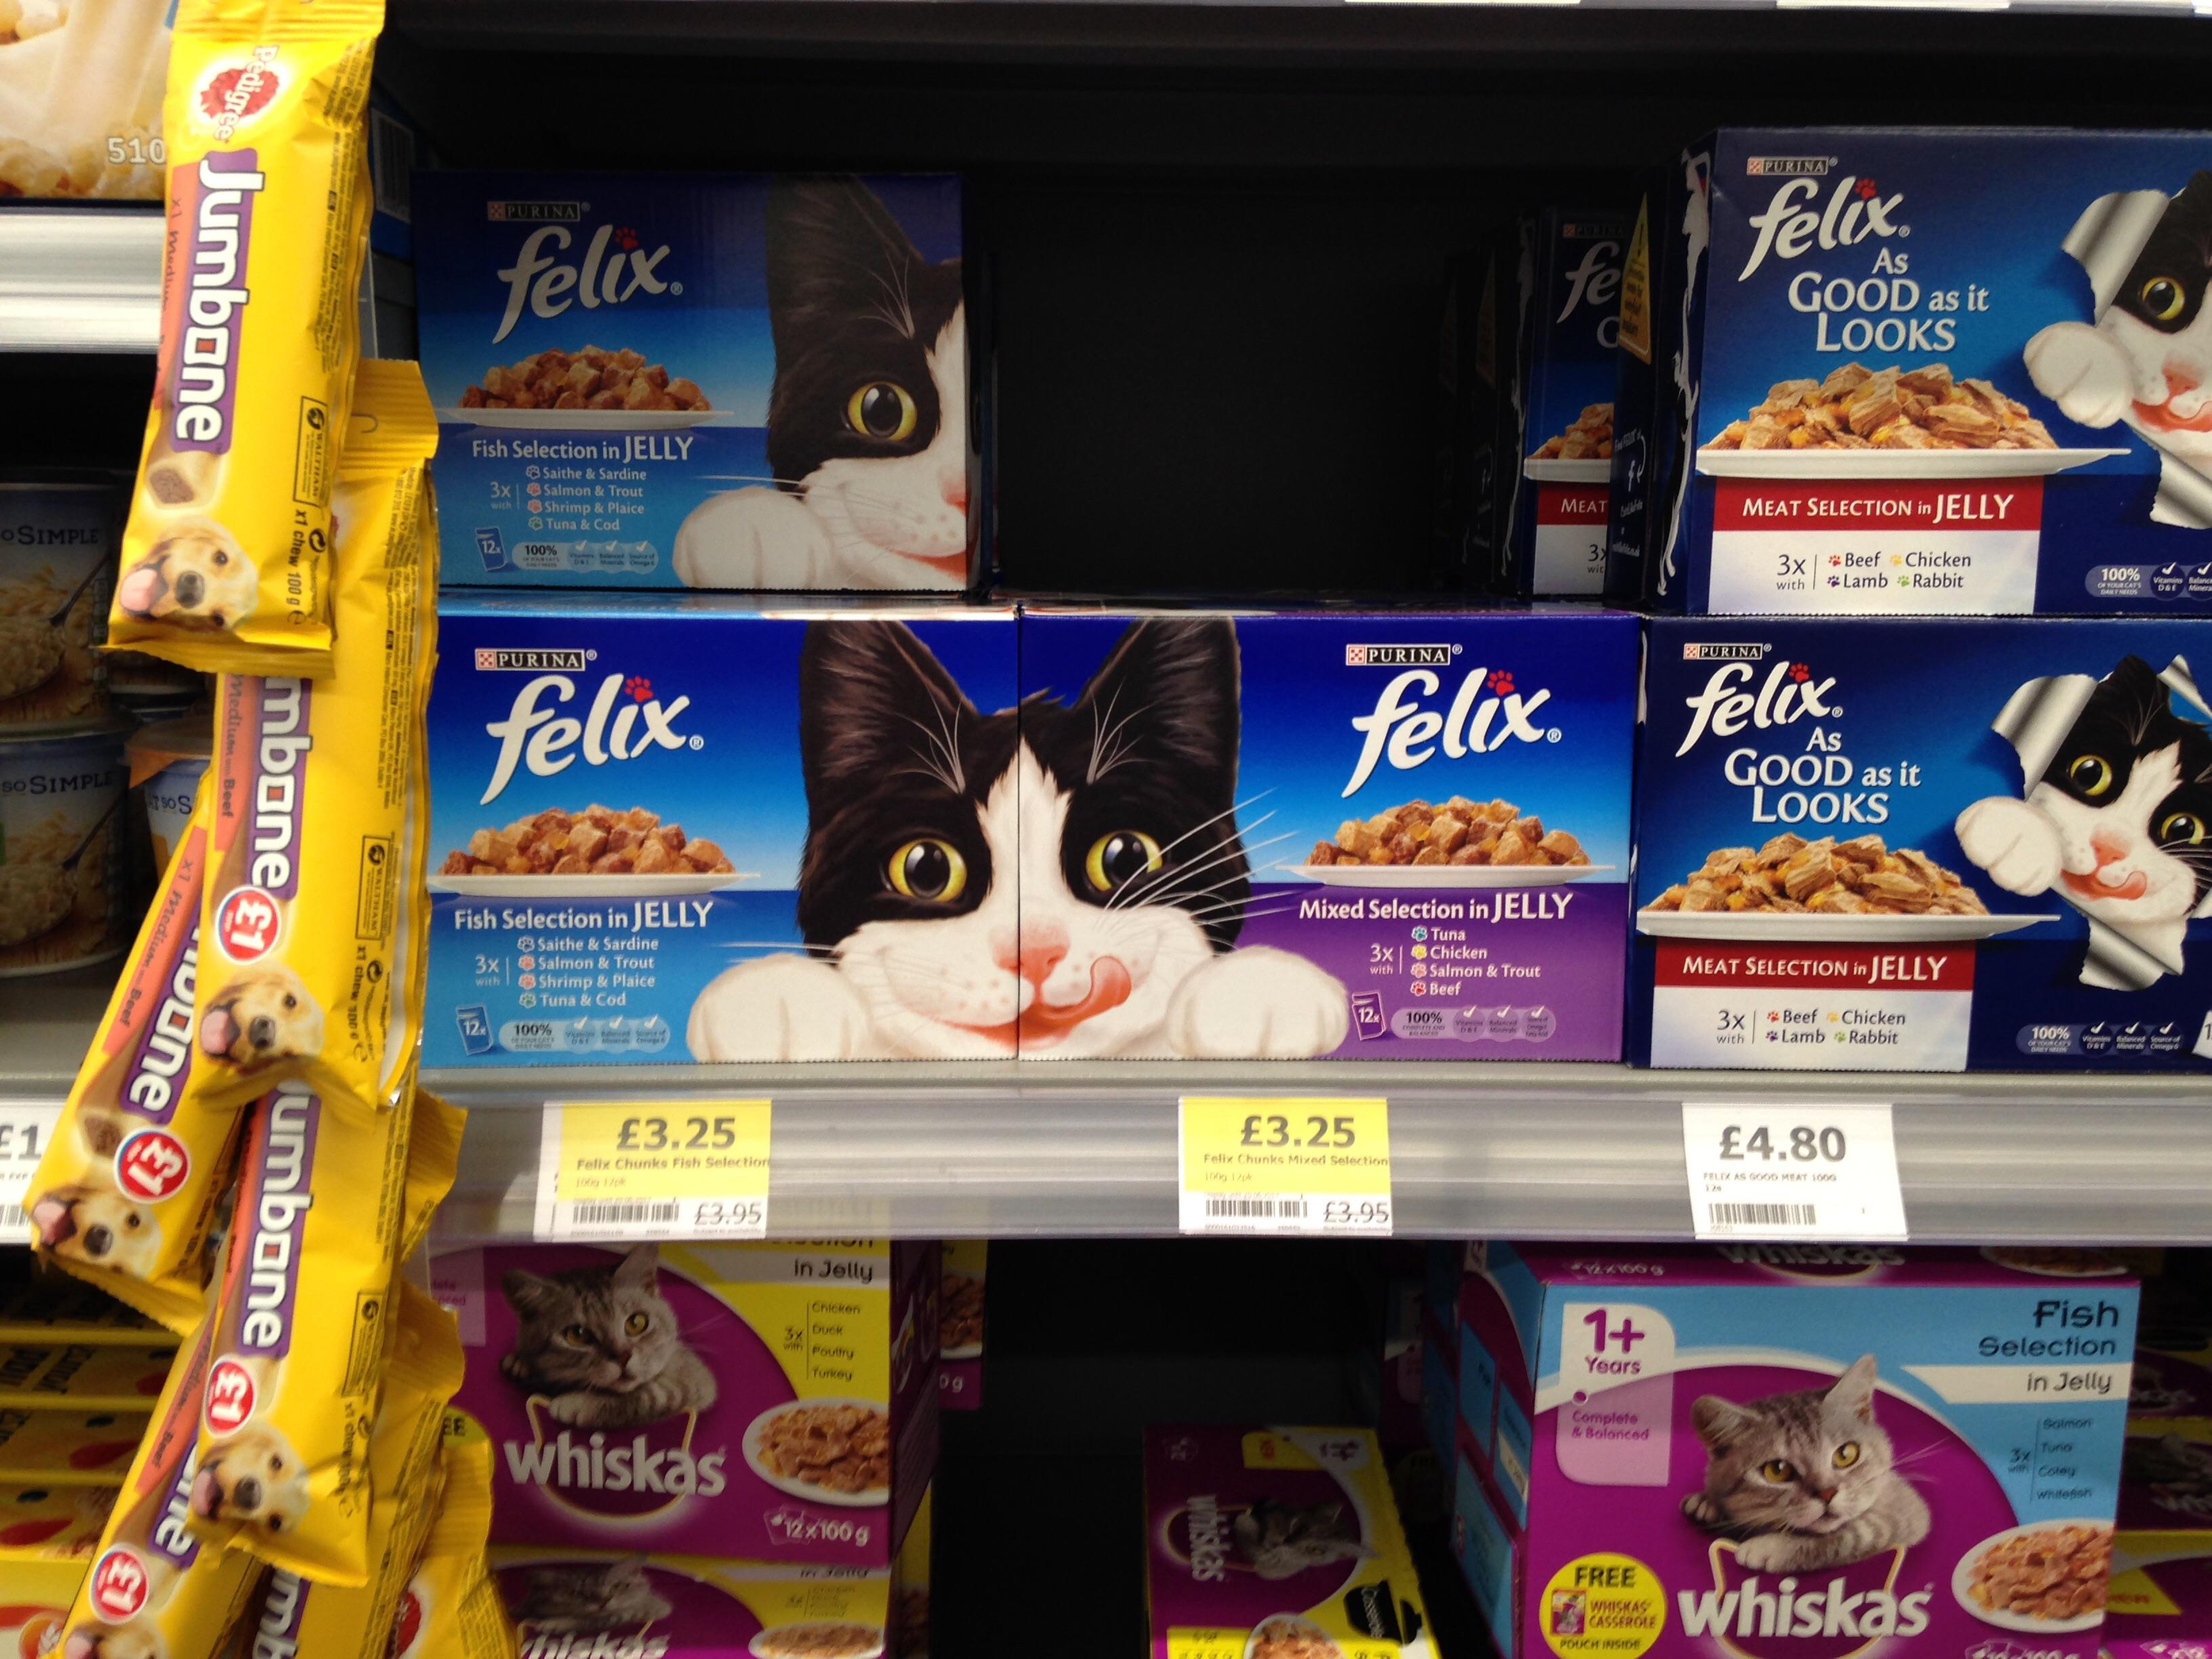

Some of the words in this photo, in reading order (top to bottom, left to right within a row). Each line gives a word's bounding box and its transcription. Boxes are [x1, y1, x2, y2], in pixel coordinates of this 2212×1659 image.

[213, 45, 279, 140] Pedigree
[1763, 161, 1826, 173] PURINA
[508, 204, 575, 219] PURINA
[1738, 176, 1904, 282] felix
[1872, 247, 1909, 274] As
[492, 224, 670, 344] felix
[1788, 272, 1920, 313] GOOD
[1928, 291, 1959, 312] as
[1967, 284, 1990, 312] it
[175, 159, 265, 442] Jumbone
[1816, 312, 1957, 352] LOOKS
[473, 439, 508, 458] Fish
[513, 440, 600, 459] Selection
[602, 441, 620, 459] in
[623, 436, 694, 464] JELLY
[544, 468, 583, 480] Saithe
[599, 468, 647, 480] Sardine
[544, 484, 592, 497] Salmon
[609, 485, 644, 497] Trout
[544, 501, 591, 515] Shrimp
[608, 501, 644, 514] Plaice
[1561, 498, 1608, 514] MEAT
[1742, 497, 1803, 518] MEAT
[1807, 497, 1912, 518] SELECTION
[1918, 499, 1931, 516] in
[1933, 493, 2014, 525] JELLY
[546, 518, 577, 531] Tuna
[580, 519, 590, 531] &
[594, 518, 621, 531] Cod
[18, 525, 99, 546] SIMPLE
[287, 529, 305, 567] chew
[525, 544, 558, 556] 100%
[1776, 554, 1806, 577] 3x
[1845, 551, 1881, 569] Beef
[1905, 552, 1972, 569] Chicken
[1776, 577, 1805, 591] with
[1843, 572, 1889, 590] Lamb
[1912, 572, 1965, 590] Rabbit
[2101, 567, 2141, 581] 100%
[498, 652, 581, 668] PURINA
[1368, 647, 1446, 663] PURINA
[1700, 646, 1759, 658] PURINA
[1675, 661, 1837, 758] felix
[480, 673, 691, 806] felix
[1341, 667, 1551, 798] felix
[1806, 726, 1842, 752] As
[1724, 747, 1853, 786] GOOD
[1862, 766, 1892, 787] as
[1900, 760, 1922, 787] it
[1752, 785, 1890, 823] LOOKS
[454, 908, 497, 930] Fish
[501, 908, 602, 930] Selection
[608, 907, 628, 929] in
[632, 900, 714, 933] JELLY
[1299, 899, 1364, 920] Mixed
[1368, 898, 1464, 920] Selection
[1469, 898, 1489, 920] in
[1491, 892, 1573, 923] JELLY
[230, 898, 272, 953] £1
[1430, 927, 1467, 941] Tuna
[537, 937, 584, 951] Saithe
[587, 937, 600, 951] &
[603, 937, 660, 951] Sardine
[1429, 945, 1488, 960] Chicken
[537, 955, 594, 970] Salmon
[598, 956, 611, 969] &
[614, 955, 655, 970] Trout
[1370, 964, 1393, 975] with
[1429, 963, 1483, 978] Salmon
[1486, 964, 1498, 977] &
[1501, 964, 1541, 978] Trout
[1683, 956, 1741, 975] MEAT
[1746, 956, 1849, 976] SELECTION
[1853, 961, 1867, 976] in
[1868, 956, 1948, 984] JELLY
[537, 974, 593, 991] Shrimp
[596, 975, 609, 988] &
[613, 974, 656, 988] Plaice
[1429, 981, 1461, 996] Beef
[540, 993, 576, 1006] Tuna
[580, 994, 592, 1006] &
[596, 992, 626, 1006] Cod
[1406, 1011, 1443, 1024] 100%
[1717, 1010, 1745, 1031] 3x
[1782, 1009, 1818, 1025] Beef
[1841, 1010, 1906, 1026] Chicken
[514, 1023, 552, 1037] 100%
[1716, 1033, 1745, 1045] with
[1782, 1029, 1826, 1044] Lamb
[1849, 1029, 1899, 1045] Rabbit
[2032, 1025, 2070, 1040] 100%
[617, 1117, 736, 1151] £3.25
[1240, 1115, 1356, 1148] £3.25
[1719, 1126, 1847, 1162] £4.80
[127, 1139, 184, 1195] £1
[576, 1158, 611, 1171] Felix
[615, 1156, 668, 1170] Chunks
[672, 1155, 701, 1169] Fish
[705, 1155, 769, 1168] Selection
[1204, 1153, 1233, 1165] Felix
[1237, 1154, 1284, 1165] Chunks
[1288, 1154, 1326, 1166] Mixed
[1330, 1155, 1389, 1166] Selection
[1703, 1172, 1731, 1181] FELIX
[1749, 1173, 1778, 1181] GOOD
[693, 1202, 762, 1225] £3.95
[1323, 1202, 1389, 1224] £3.95
[794, 1259, 813, 1277] in
[818, 1260, 873, 1284] Jelly
[811, 1300, 861, 1315] Chicken
[2033, 1300, 2119, 1328] Fish
[812, 1325, 843, 1336] Duck
[1584, 1308, 1645, 1354] 1+
[812, 1347, 854, 1361] Poultry
[1978, 1335, 2116, 1357] Selection
[812, 1368, 853, 1382] Turkey
[1584, 1355, 1641, 1376] Years
[2027, 1372, 2047, 1393] in
[2053, 1372, 2113, 1395] Jelly
[211, 1369, 249, 1423] £1
[1572, 1410, 1639, 1427] Complete
[2042, 1416, 2093, 1430] Salmon
[1585, 1427, 1650, 1442] Balanced
[2040, 1441, 2073, 1454] Tuna
[503, 1430, 726, 1496] whiskas
[2037, 1465, 2076, 1479] Coley
[1574, 1565, 1637, 1589] FREE
[101, 1561, 142, 1614] £1
[1590, 1600, 1652, 1615] WHISKAS
[1677, 1575, 1931, 1639] whiskas
[1589, 1614, 1657, 1630] CASSEROLE
[1559, 1638, 1599, 1650] POUCH
[1601, 1638, 1641, 1650] INSIDE
